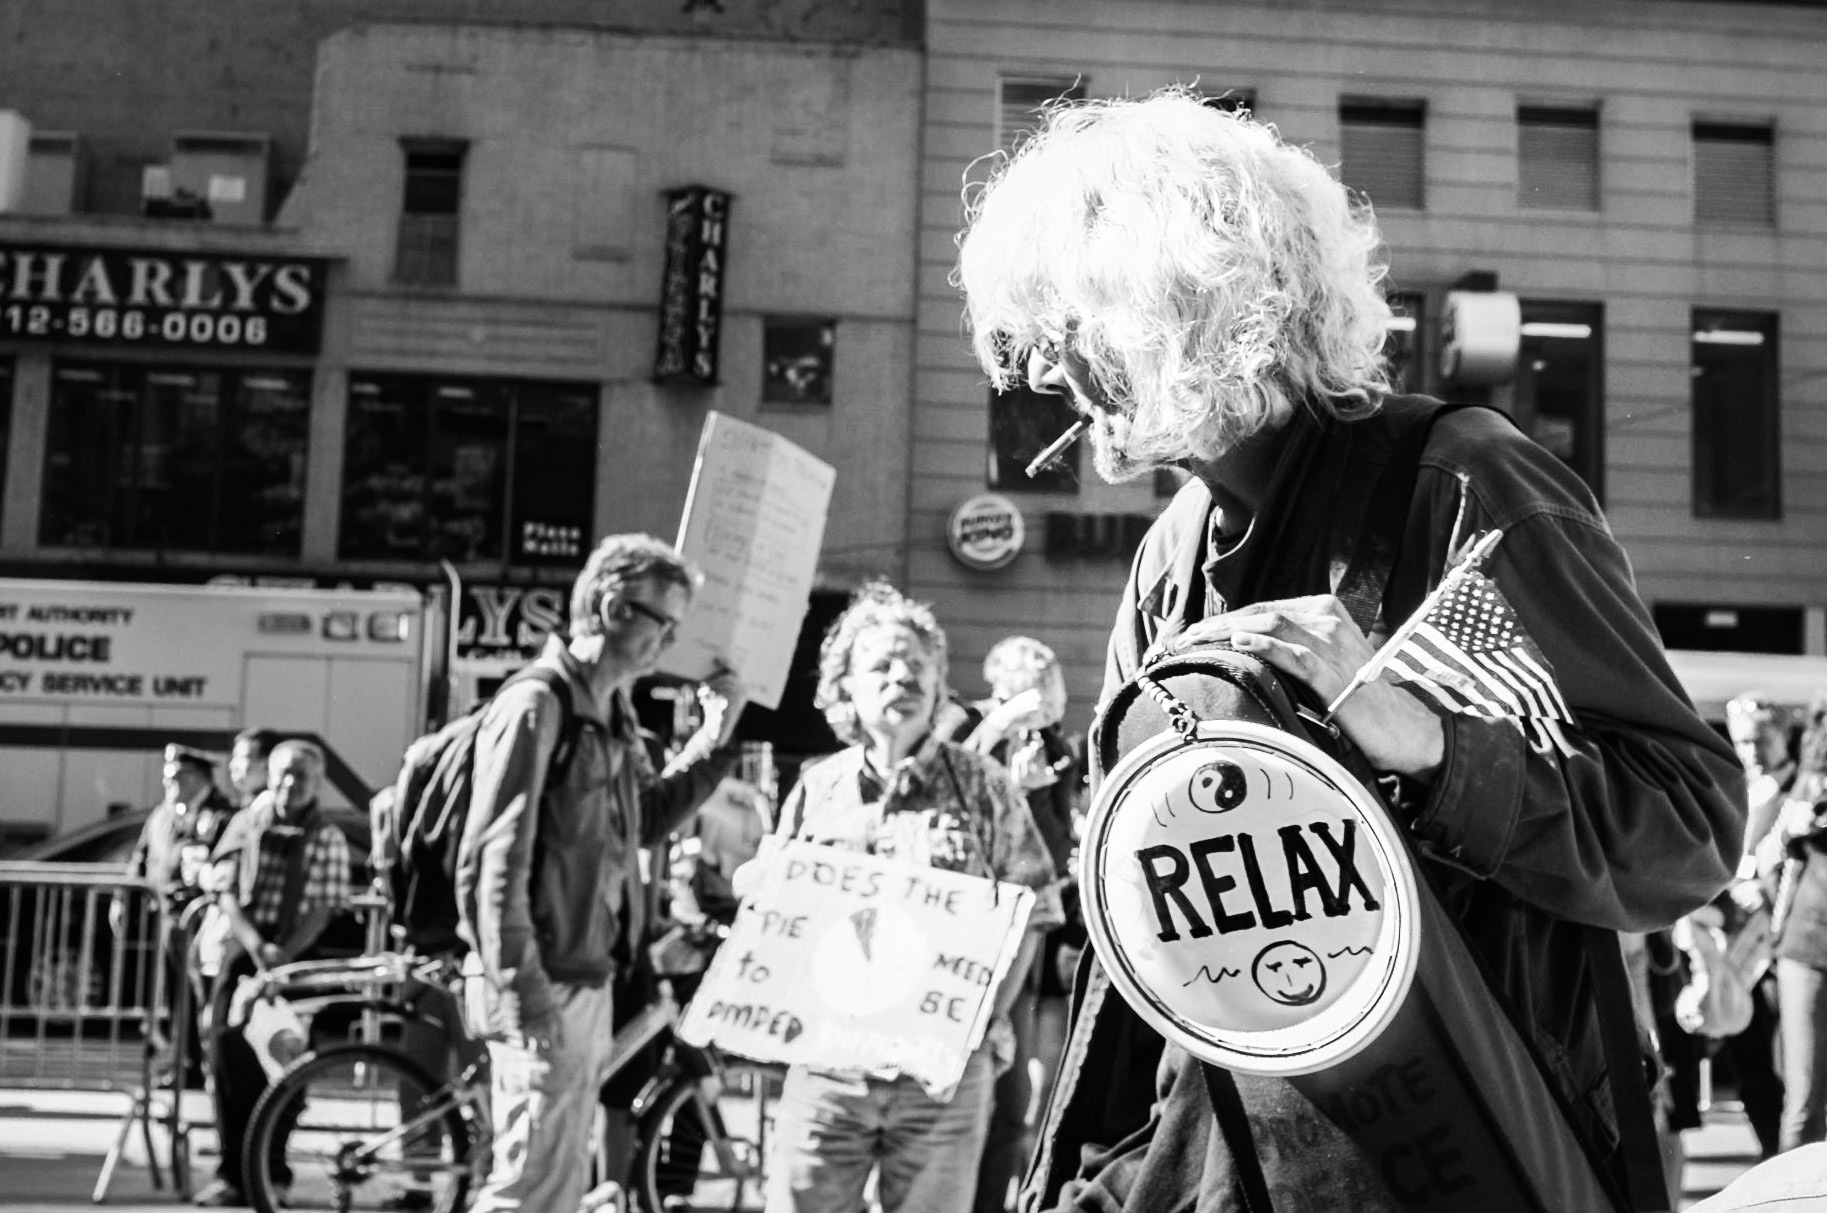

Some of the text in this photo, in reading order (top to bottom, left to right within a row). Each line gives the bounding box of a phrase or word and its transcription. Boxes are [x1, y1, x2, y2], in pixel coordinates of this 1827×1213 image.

[27, 605, 134, 624] AUTHORITY
[0, 633, 111, 662] POLICE
[42, 672, 142, 696] SERVICE
[153, 675, 208, 698] UNIT
[786, 860, 964, 915] DOES THE
[1134, 819, 1382, 943] RELAX
[762, 909, 808, 939] PIE
